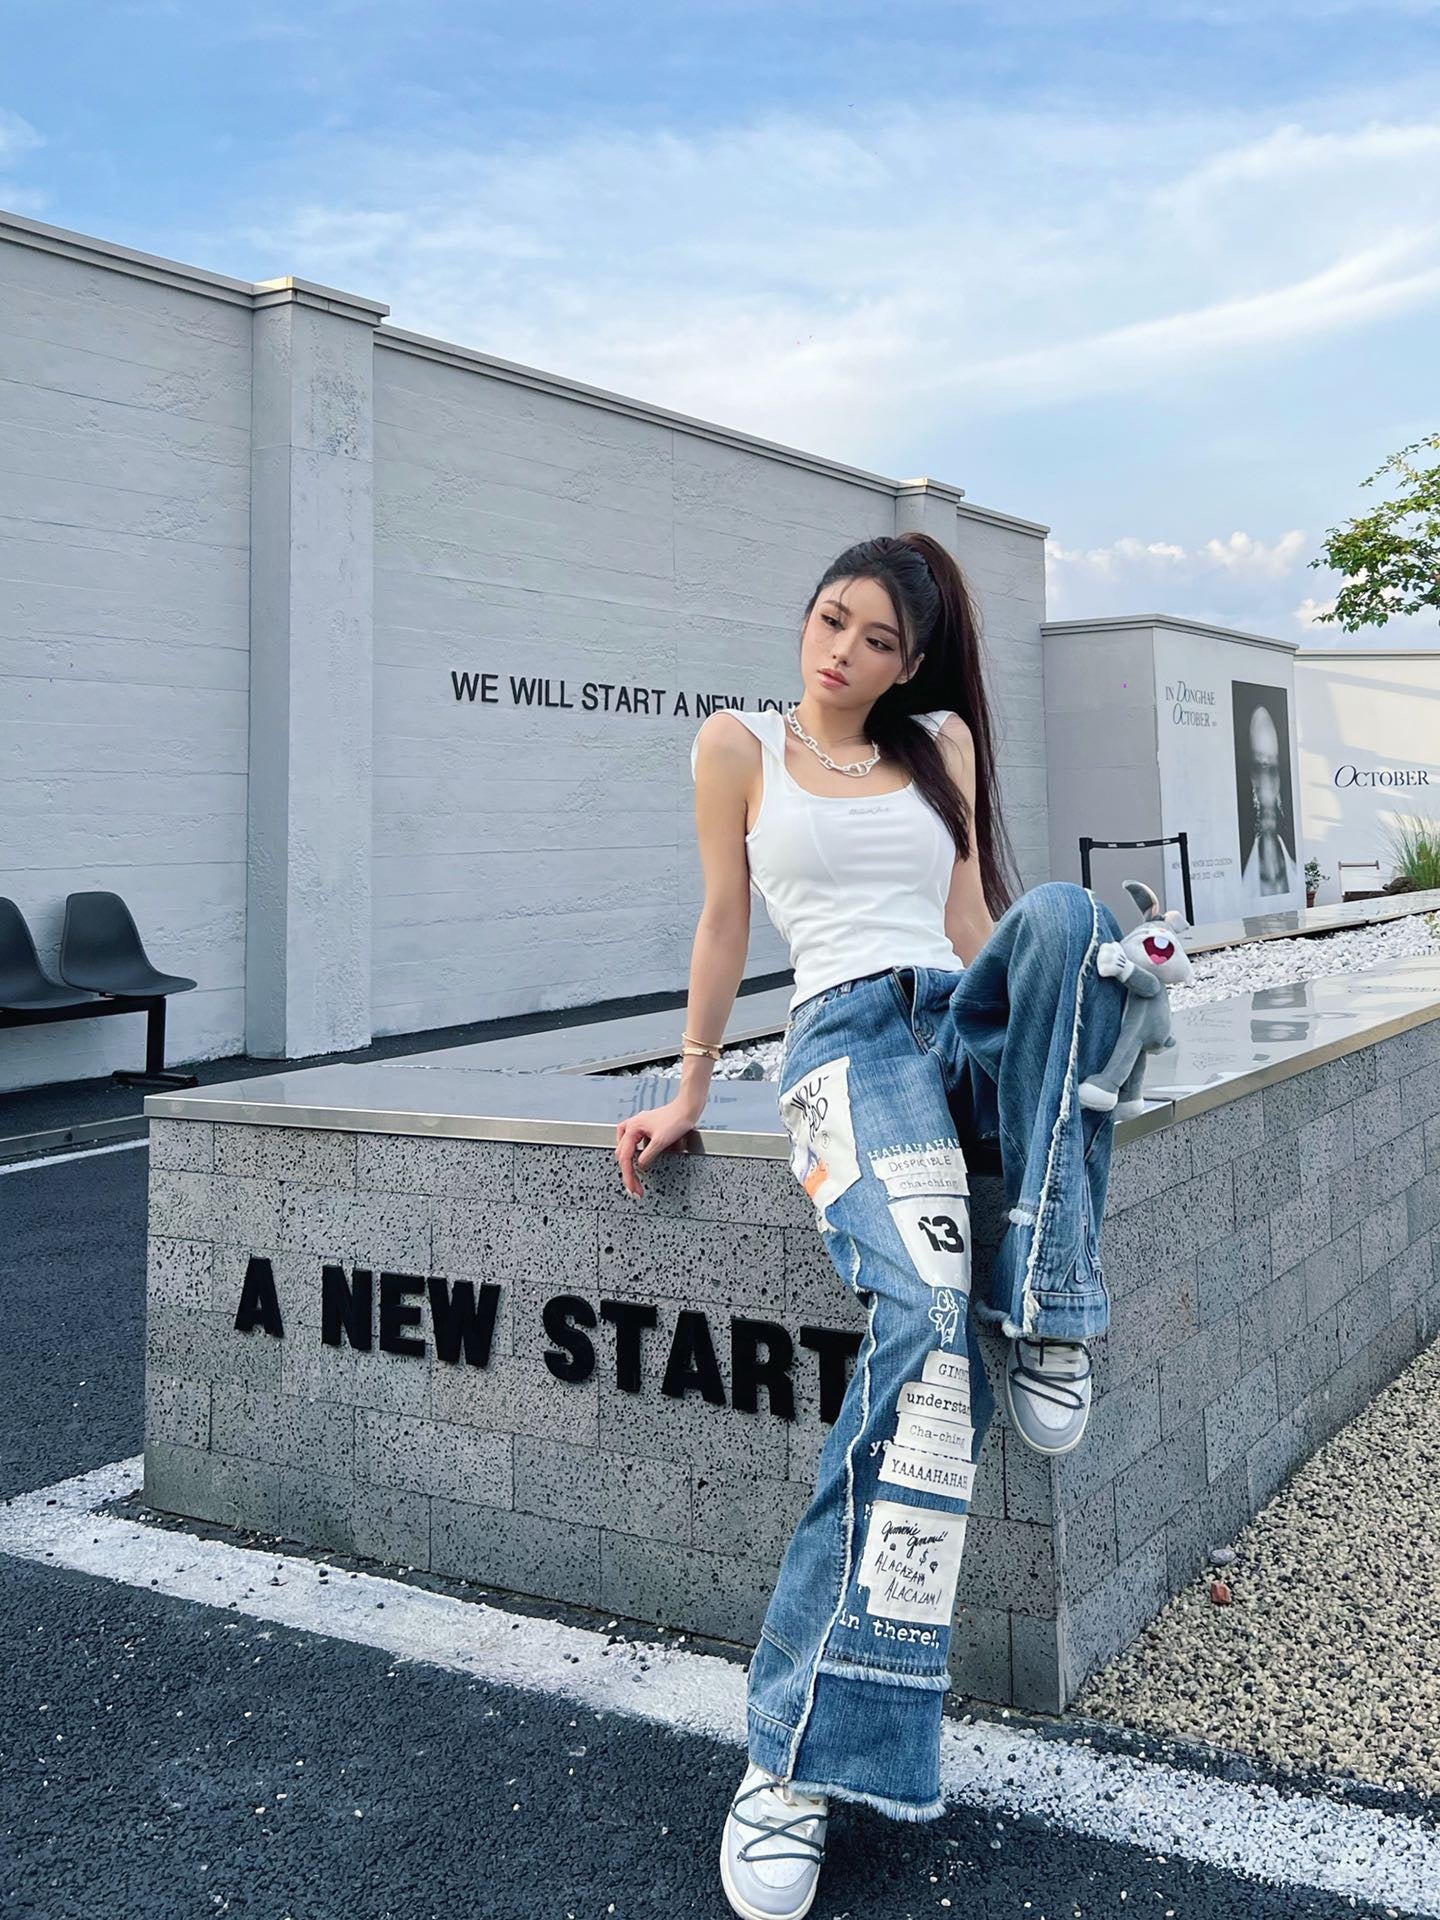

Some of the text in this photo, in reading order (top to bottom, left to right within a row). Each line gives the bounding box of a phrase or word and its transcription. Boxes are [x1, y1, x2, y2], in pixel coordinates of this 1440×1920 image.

[451, 670, 498, 702] WE
[509, 676, 574, 708] WILL
[581, 682, 666, 716] START
[673, 692, 690, 718] A
[1173, 702, 1211, 727] OCTOBER
[1334, 764, 1430, 788] OCTOBER
[917, 1215, 965, 1254] 13
[234, 1254, 866, 1424] A NEW START
